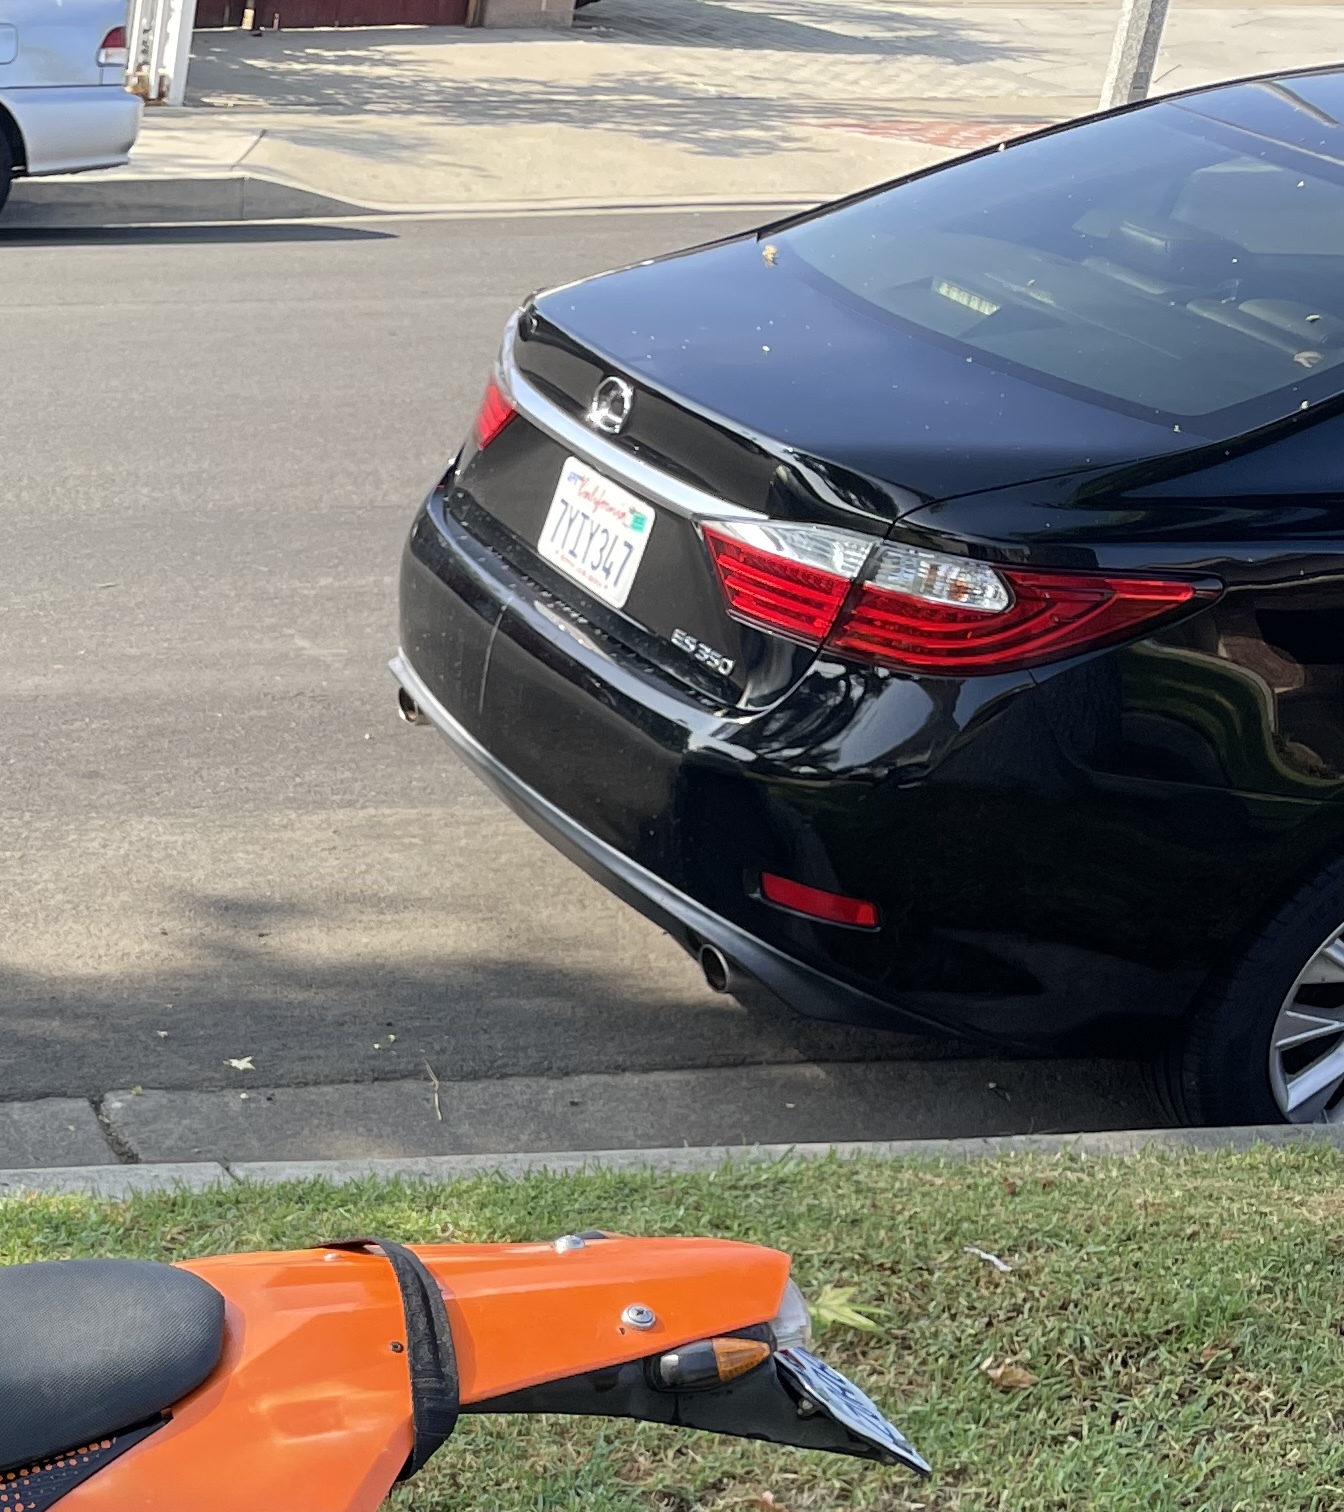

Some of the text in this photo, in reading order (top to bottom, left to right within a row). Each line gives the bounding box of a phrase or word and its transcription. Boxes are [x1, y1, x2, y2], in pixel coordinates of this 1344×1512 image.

[550, 498, 635, 588] 7YIY347
[671, 628, 735, 676] ES 350
